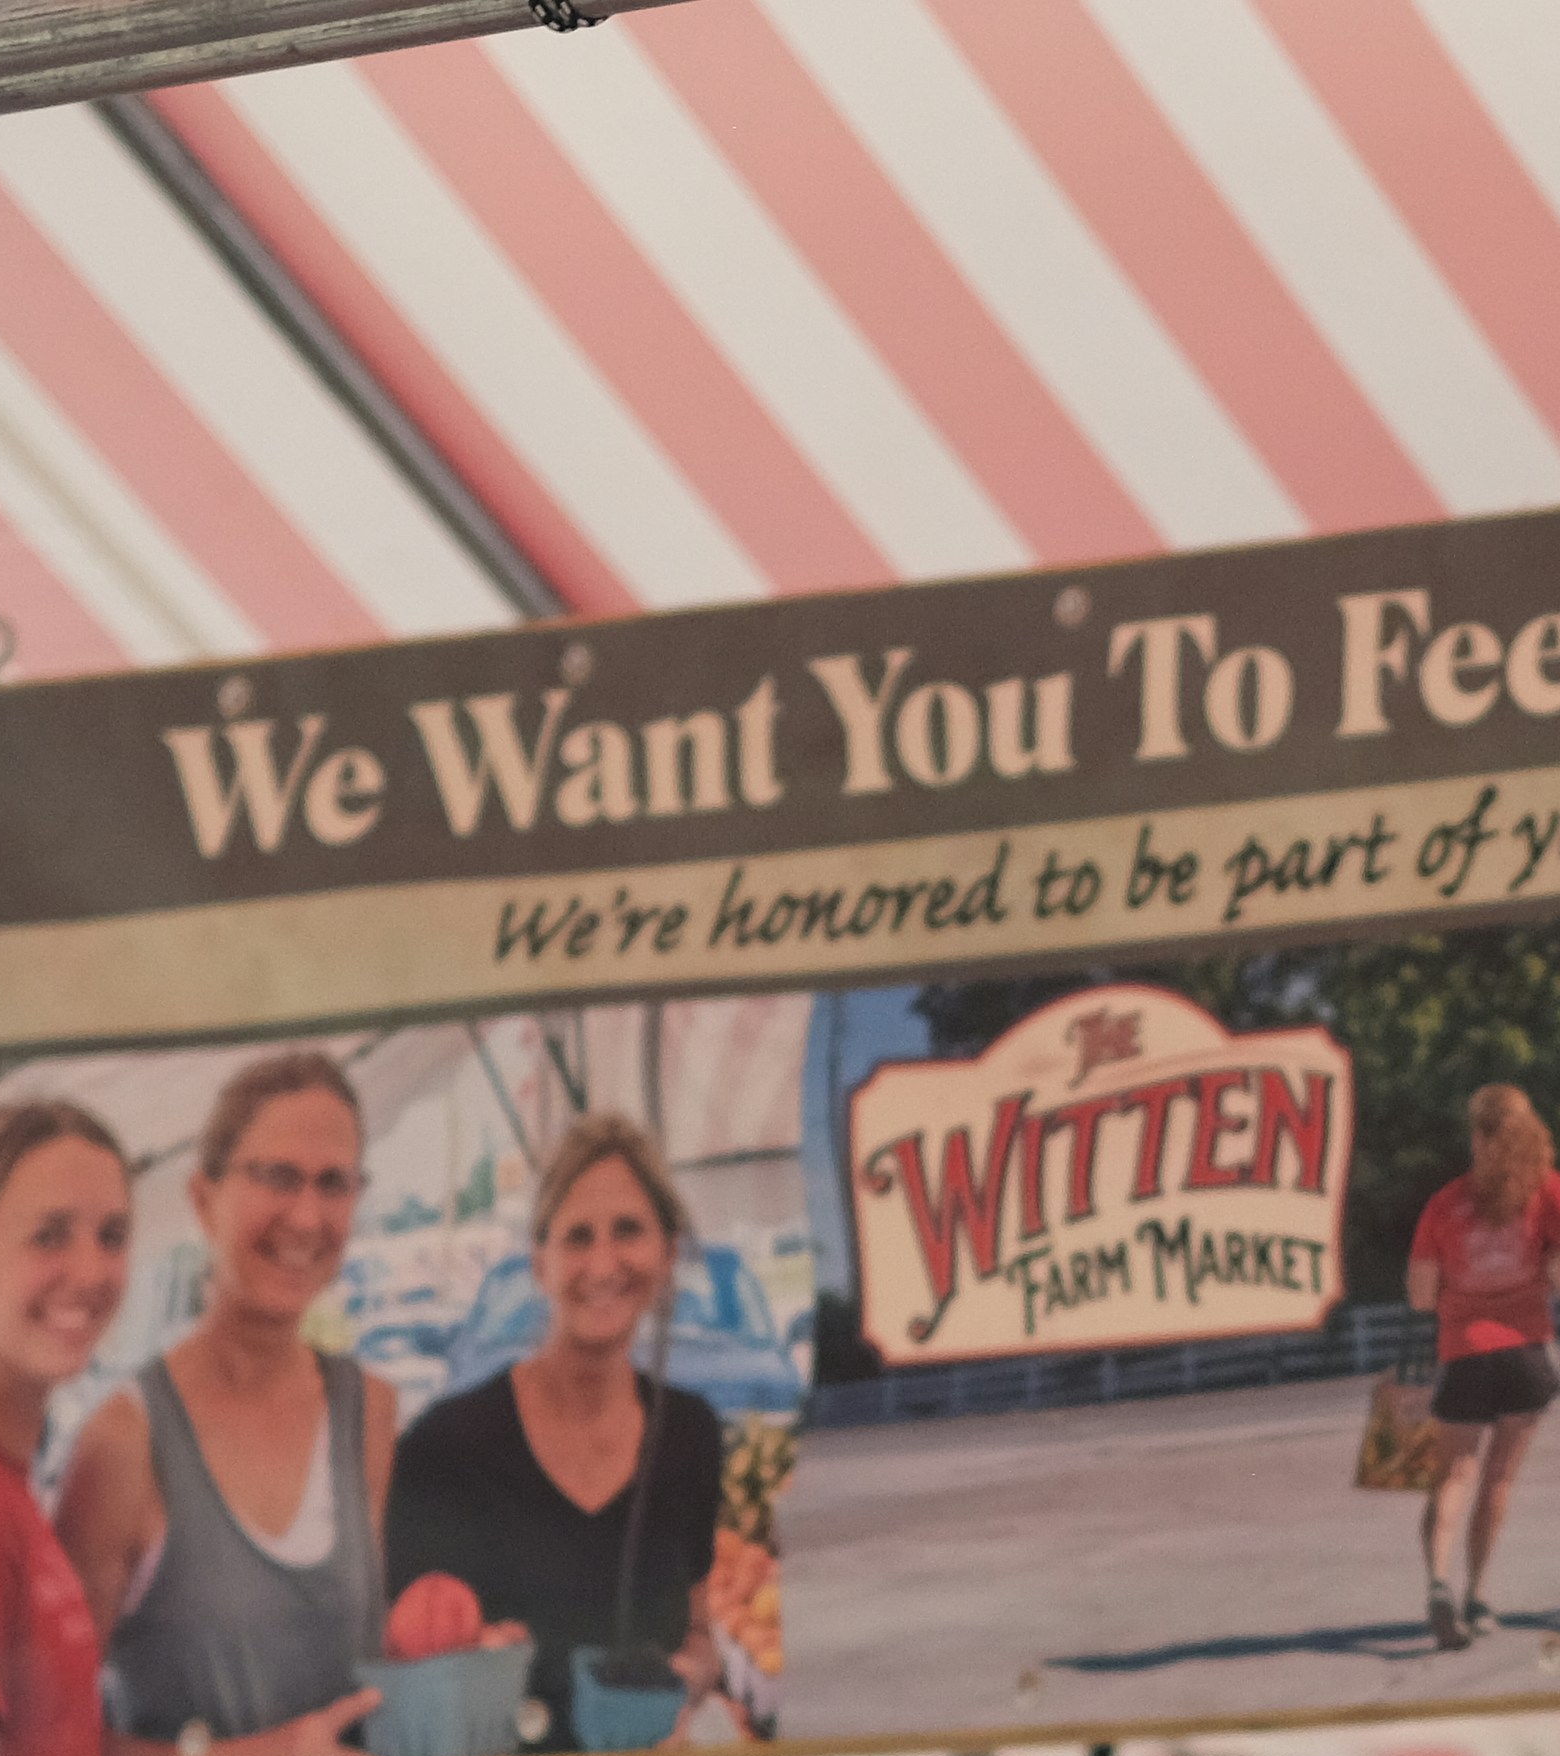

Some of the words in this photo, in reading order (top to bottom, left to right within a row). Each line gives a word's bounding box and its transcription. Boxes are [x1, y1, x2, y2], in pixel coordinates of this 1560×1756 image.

[164, 714, 385, 860] We
[413, 676, 785, 837] Want
[812, 648, 1077, 793] You
[1107, 613, 1293, 763] To
[495, 884, 686, 963] We're
[708, 840, 1006, 949] honored
[1031, 851, 1098, 922] to
[1126, 826, 1197, 909] be
[1222, 812, 1391, 927] part
[1417, 788, 1499, 897] of
[865, 1067, 1333, 1343] WITTEN
[1007, 1240, 1131, 1335] FARM
[1137, 1214, 1324, 1304] MARKET
